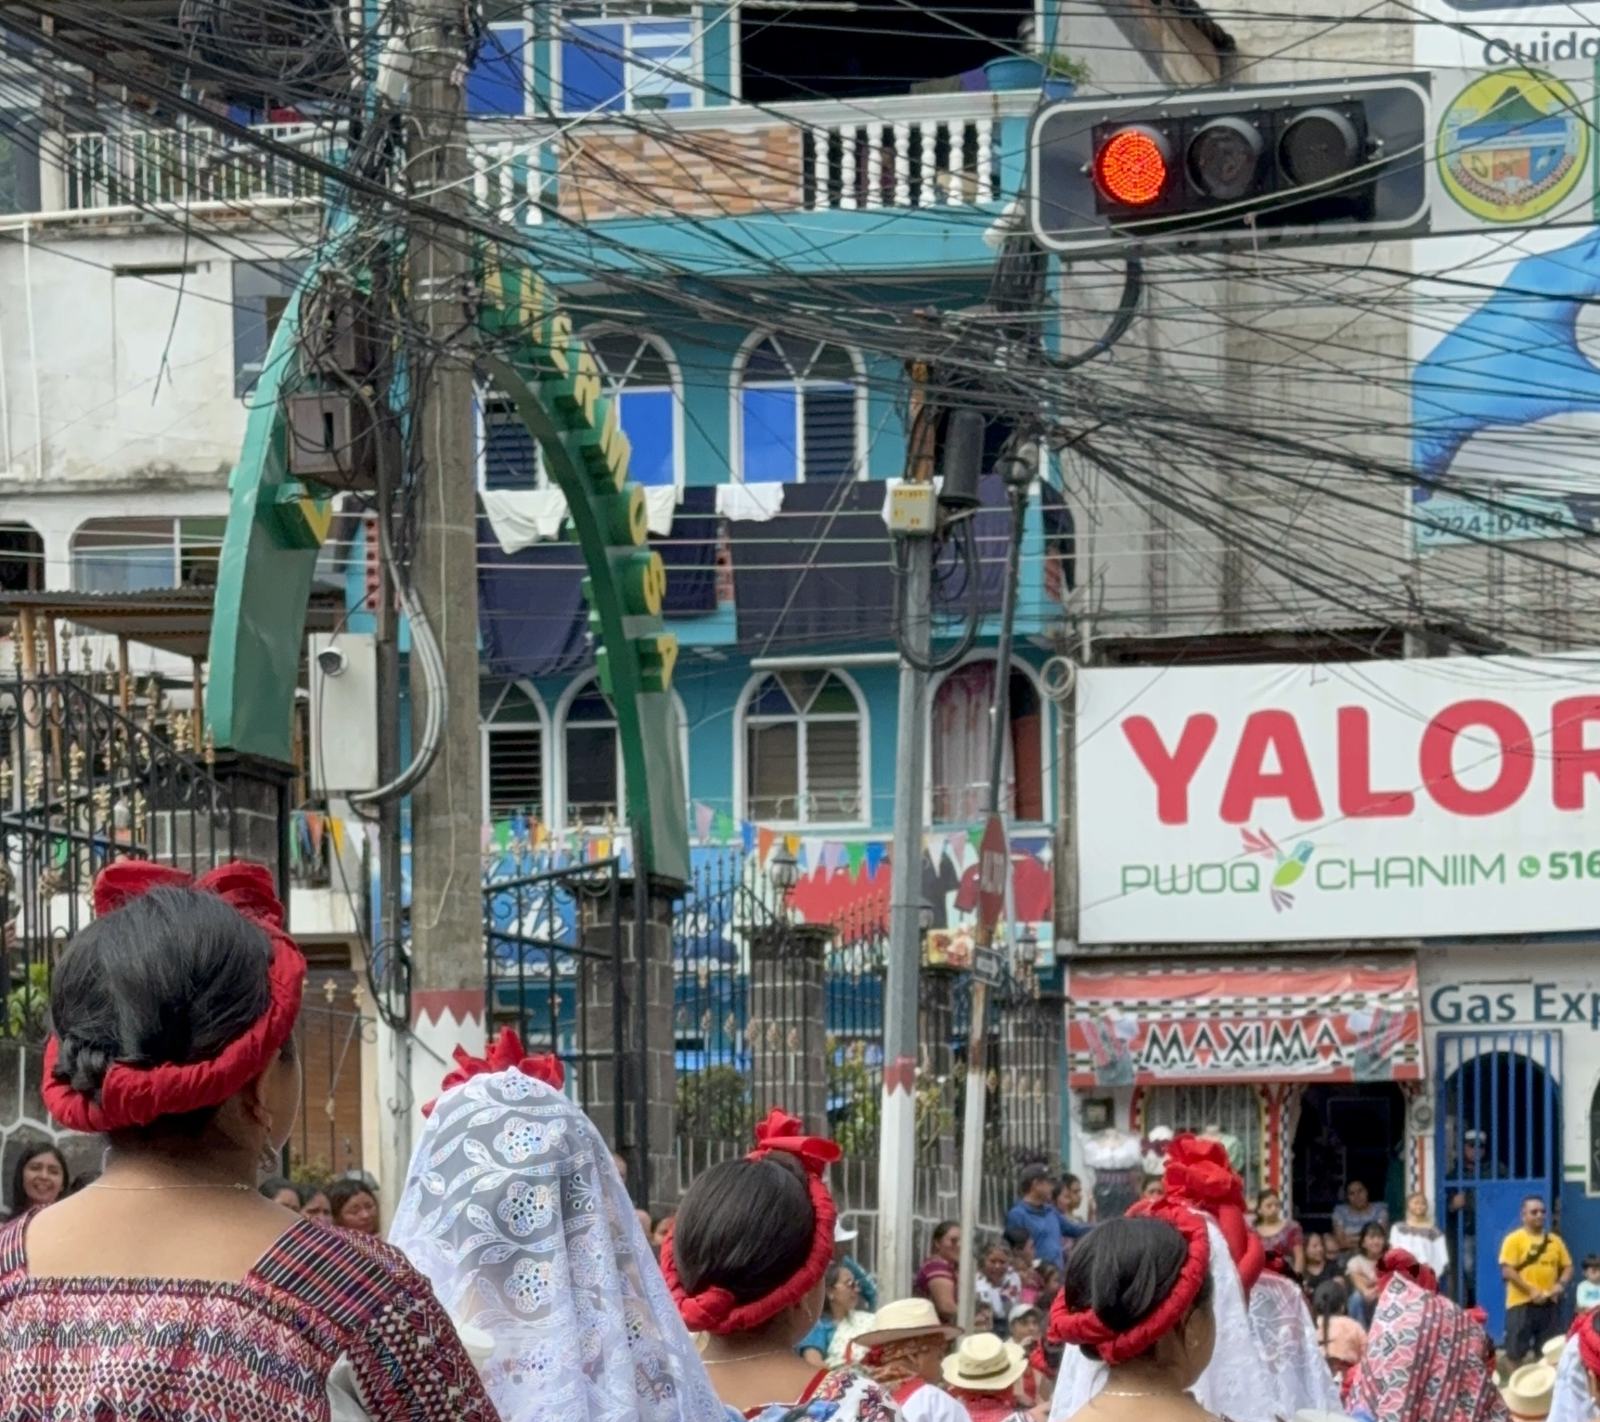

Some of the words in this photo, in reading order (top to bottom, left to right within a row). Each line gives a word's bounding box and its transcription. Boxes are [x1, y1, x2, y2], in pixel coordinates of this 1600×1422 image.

[1121, 861, 1261, 896] PWOQ
[1316, 852, 1506, 891] CHANIIM
[1430, 984, 1517, 1025] Gas
[1143, 1021, 1342, 1066] MAXIMA
